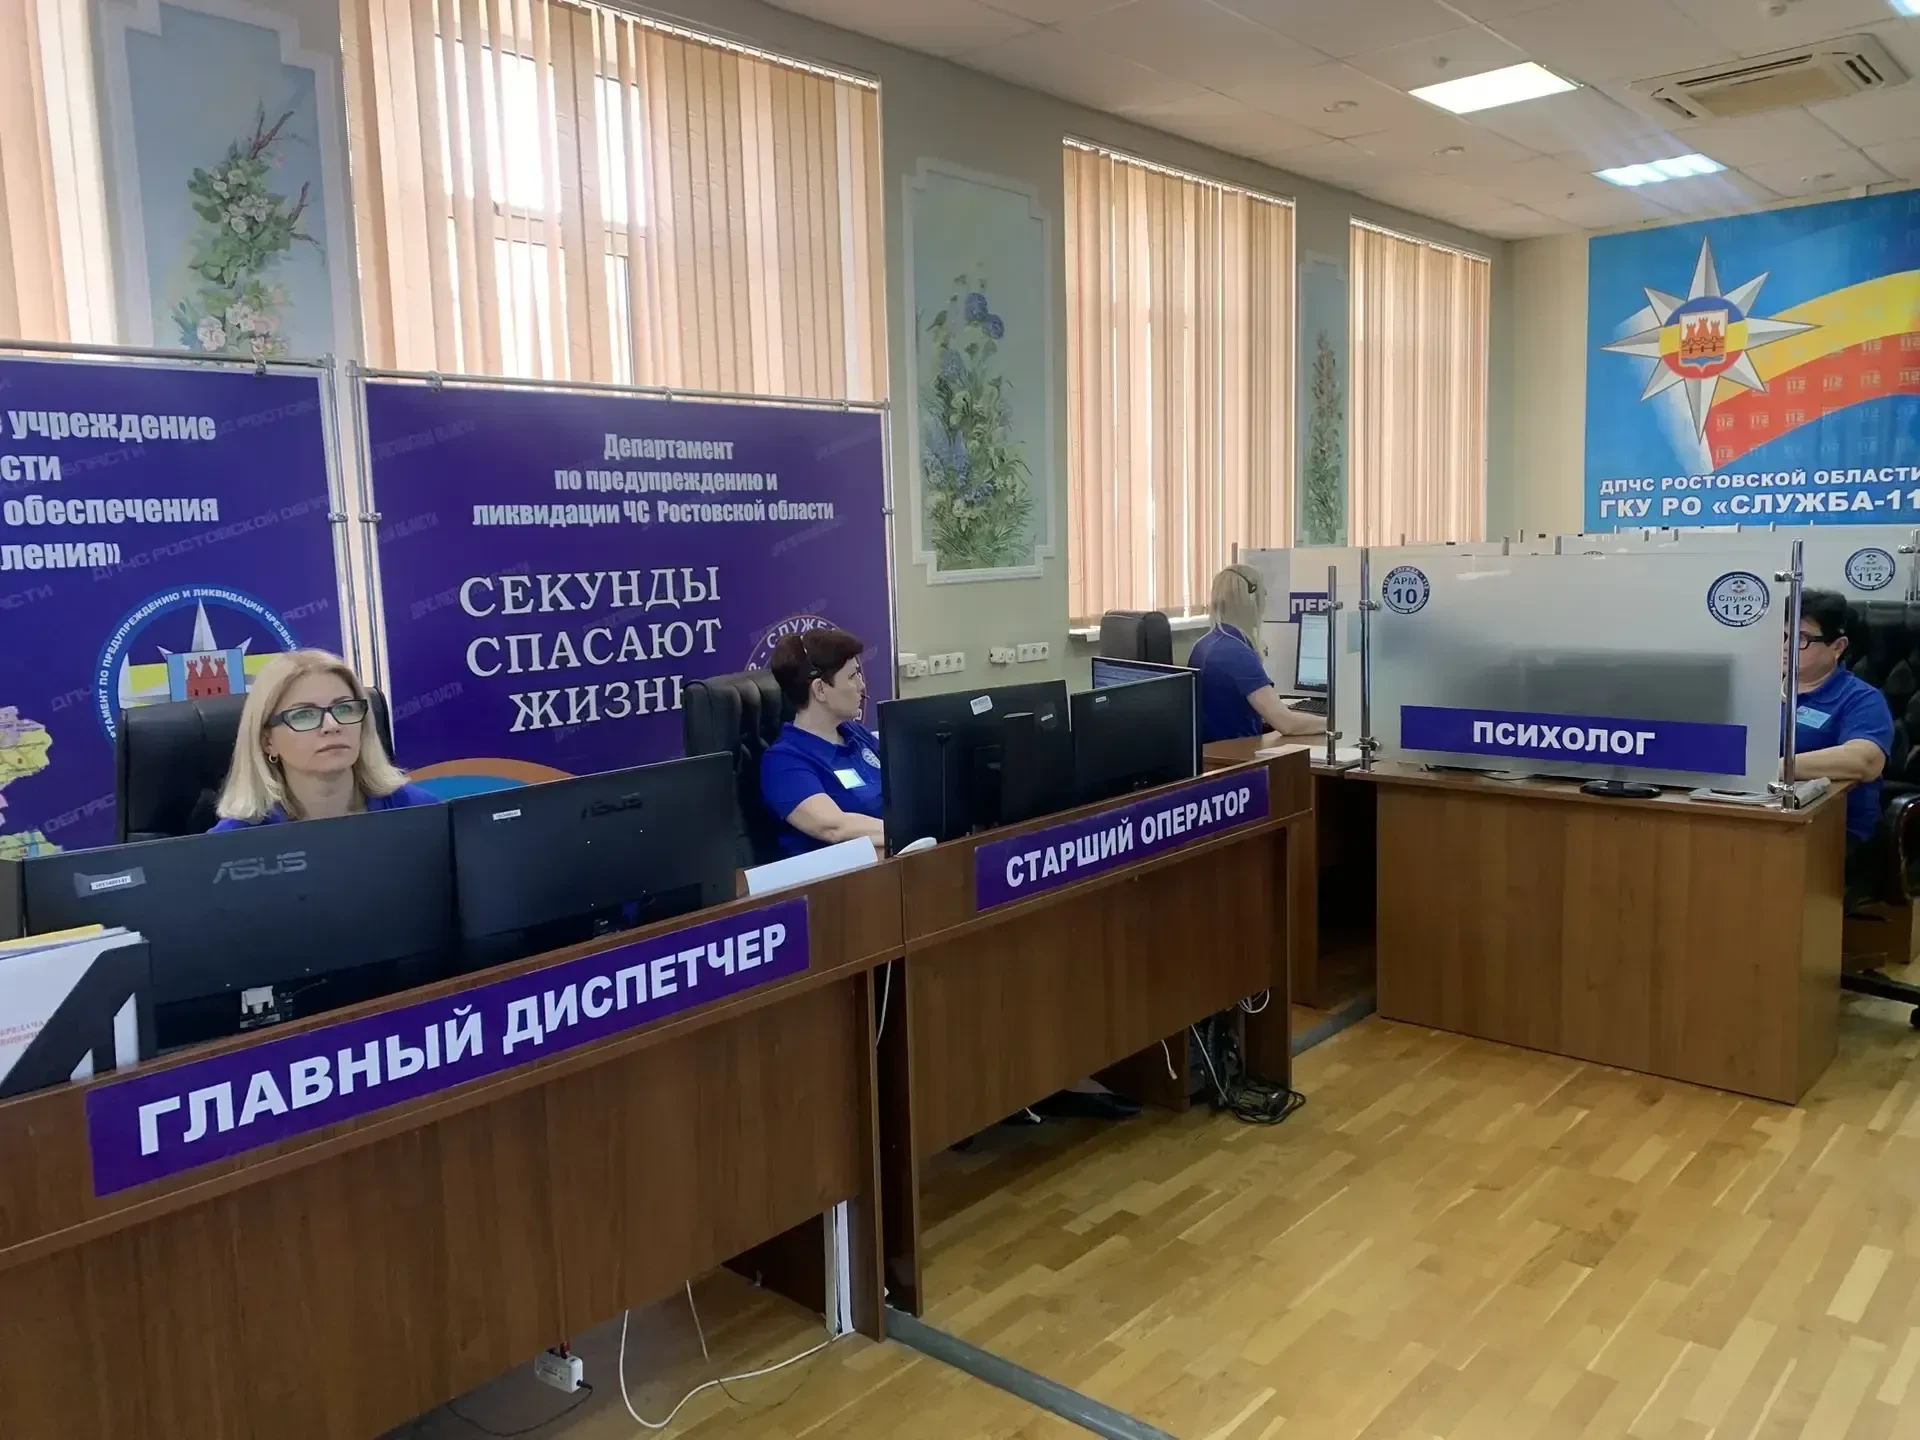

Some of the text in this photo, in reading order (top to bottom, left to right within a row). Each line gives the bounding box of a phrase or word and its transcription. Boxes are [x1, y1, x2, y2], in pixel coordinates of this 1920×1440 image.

[8, 410, 216, 443] учреждение
[603, 433, 734, 460] Департамент
[0, 455, 62, 481] сти
[554, 470, 778, 494] по предупреждению и
[1600, 466, 1920, 495] ДПЧС РОСТОВСКОЙ ОБЛАСТИ
[3, 495, 219, 525] обеспечения
[472, 499, 834, 528] ликвидации ЧС Ростовской области
[1600, 489, 1920, 518] ГКУ РО «СЛУЖБА-11
[0, 542, 121, 571] ления»
[459, 566, 721, 617] СЕКУНДЫ
[1393, 576, 1418, 585] АРМ
[1857, 572, 1882, 582] 112
[183, 590, 191, 598] И
[193, 588, 264, 614] ЛИКВИДАЦИИ
[1393, 588, 1417, 604] 10
[1718, 594, 1761, 603] Служба
[1722, 604, 1753, 616] 112
[103, 592, 180, 668] ПРЕДУПРЕЖДЕНИЮ
[767, 618, 836, 648] СЛУЖБ
[466, 617, 722, 677] СПАСАЮТ
[99, 670, 109, 686] ПО
[1473, 720, 1656, 755] ПСИХОЛОГ
[1006, 787, 1250, 888] СТАРШИЙ ОПЕРАТОР
[212, 851, 307, 884] ASUS
[138, 923, 786, 1156] ГЛАВНЫЙ ДИСПЕТЧЕР
